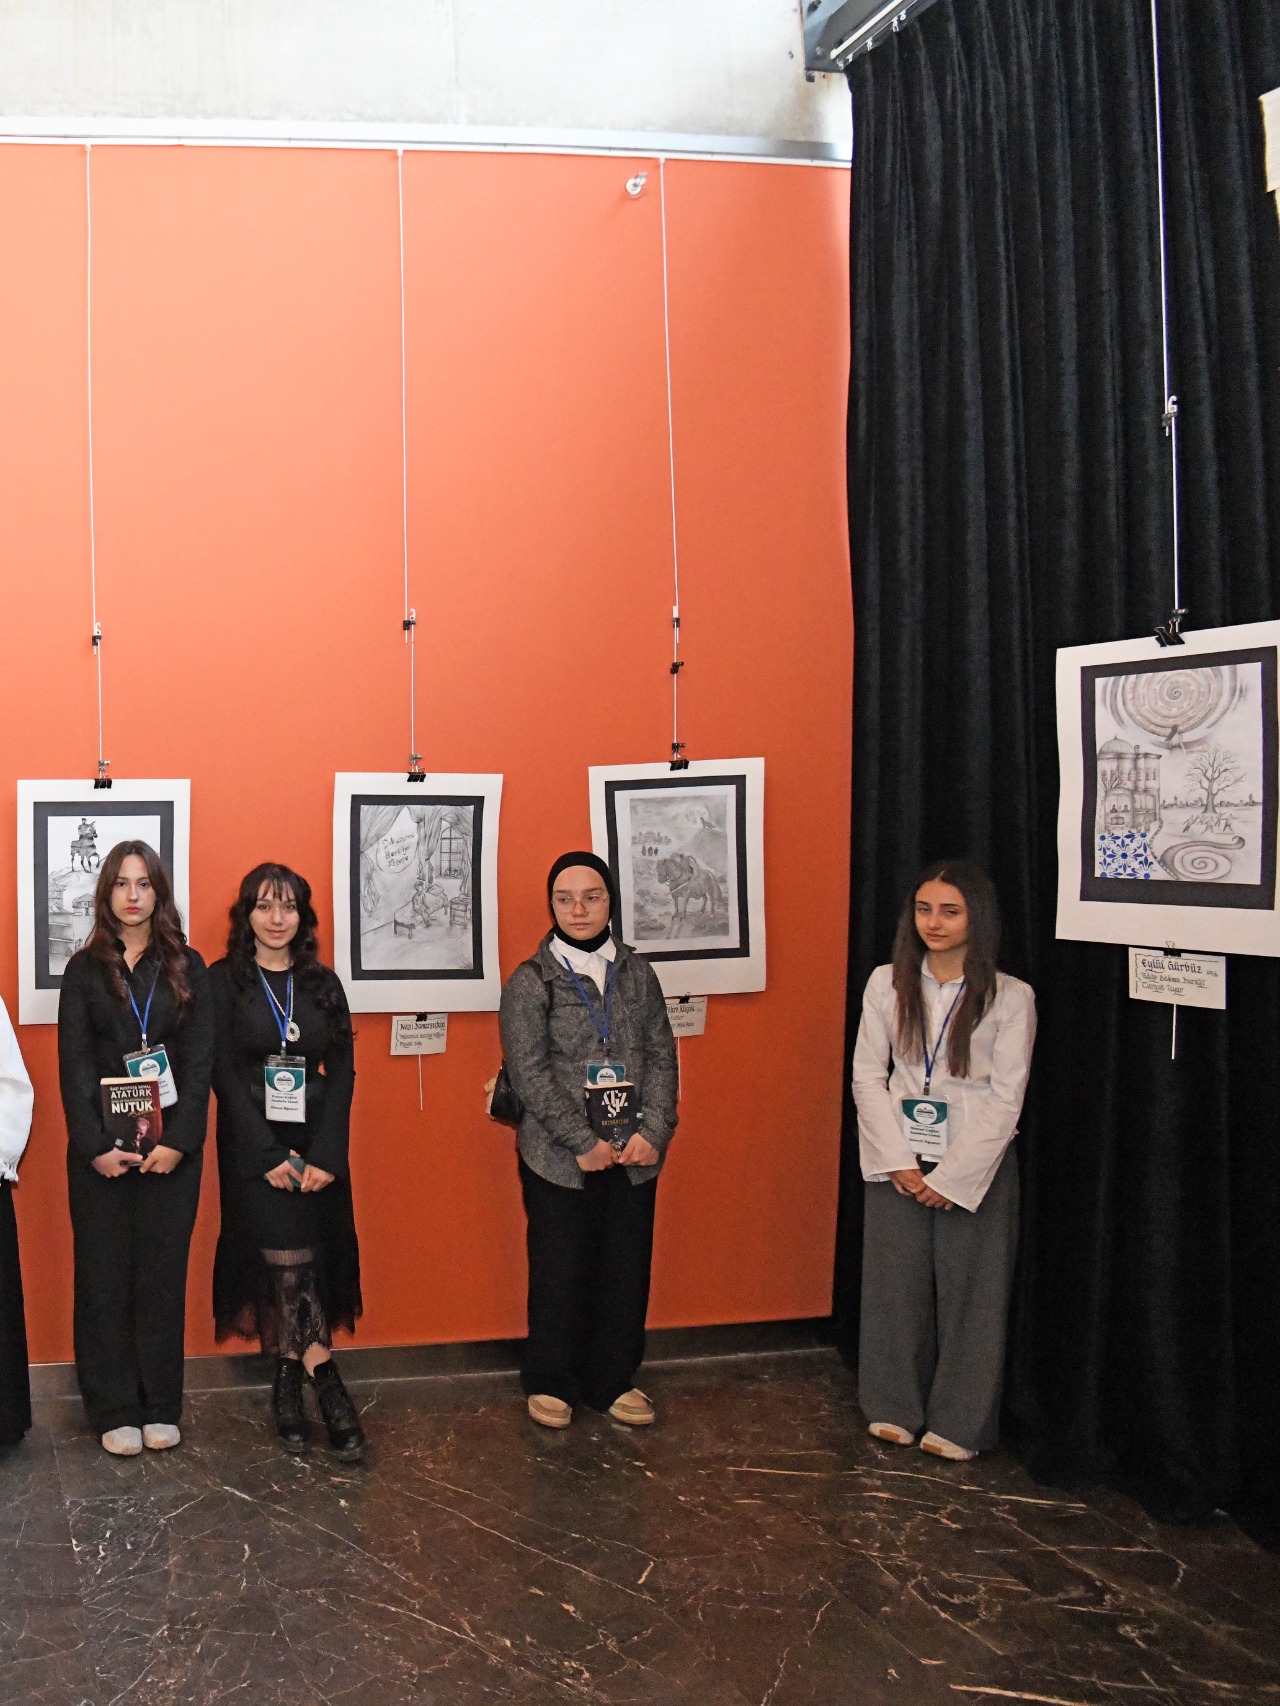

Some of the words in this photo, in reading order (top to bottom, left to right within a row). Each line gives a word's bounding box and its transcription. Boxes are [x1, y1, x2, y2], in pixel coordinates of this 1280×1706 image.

[1141, 958, 1165, 973] Eylül
[1168, 961, 1202, 974] Gürbüz
[111, 1088, 152, 1099] ATATÜRK
[111, 1101, 153, 1114] NUTUK
